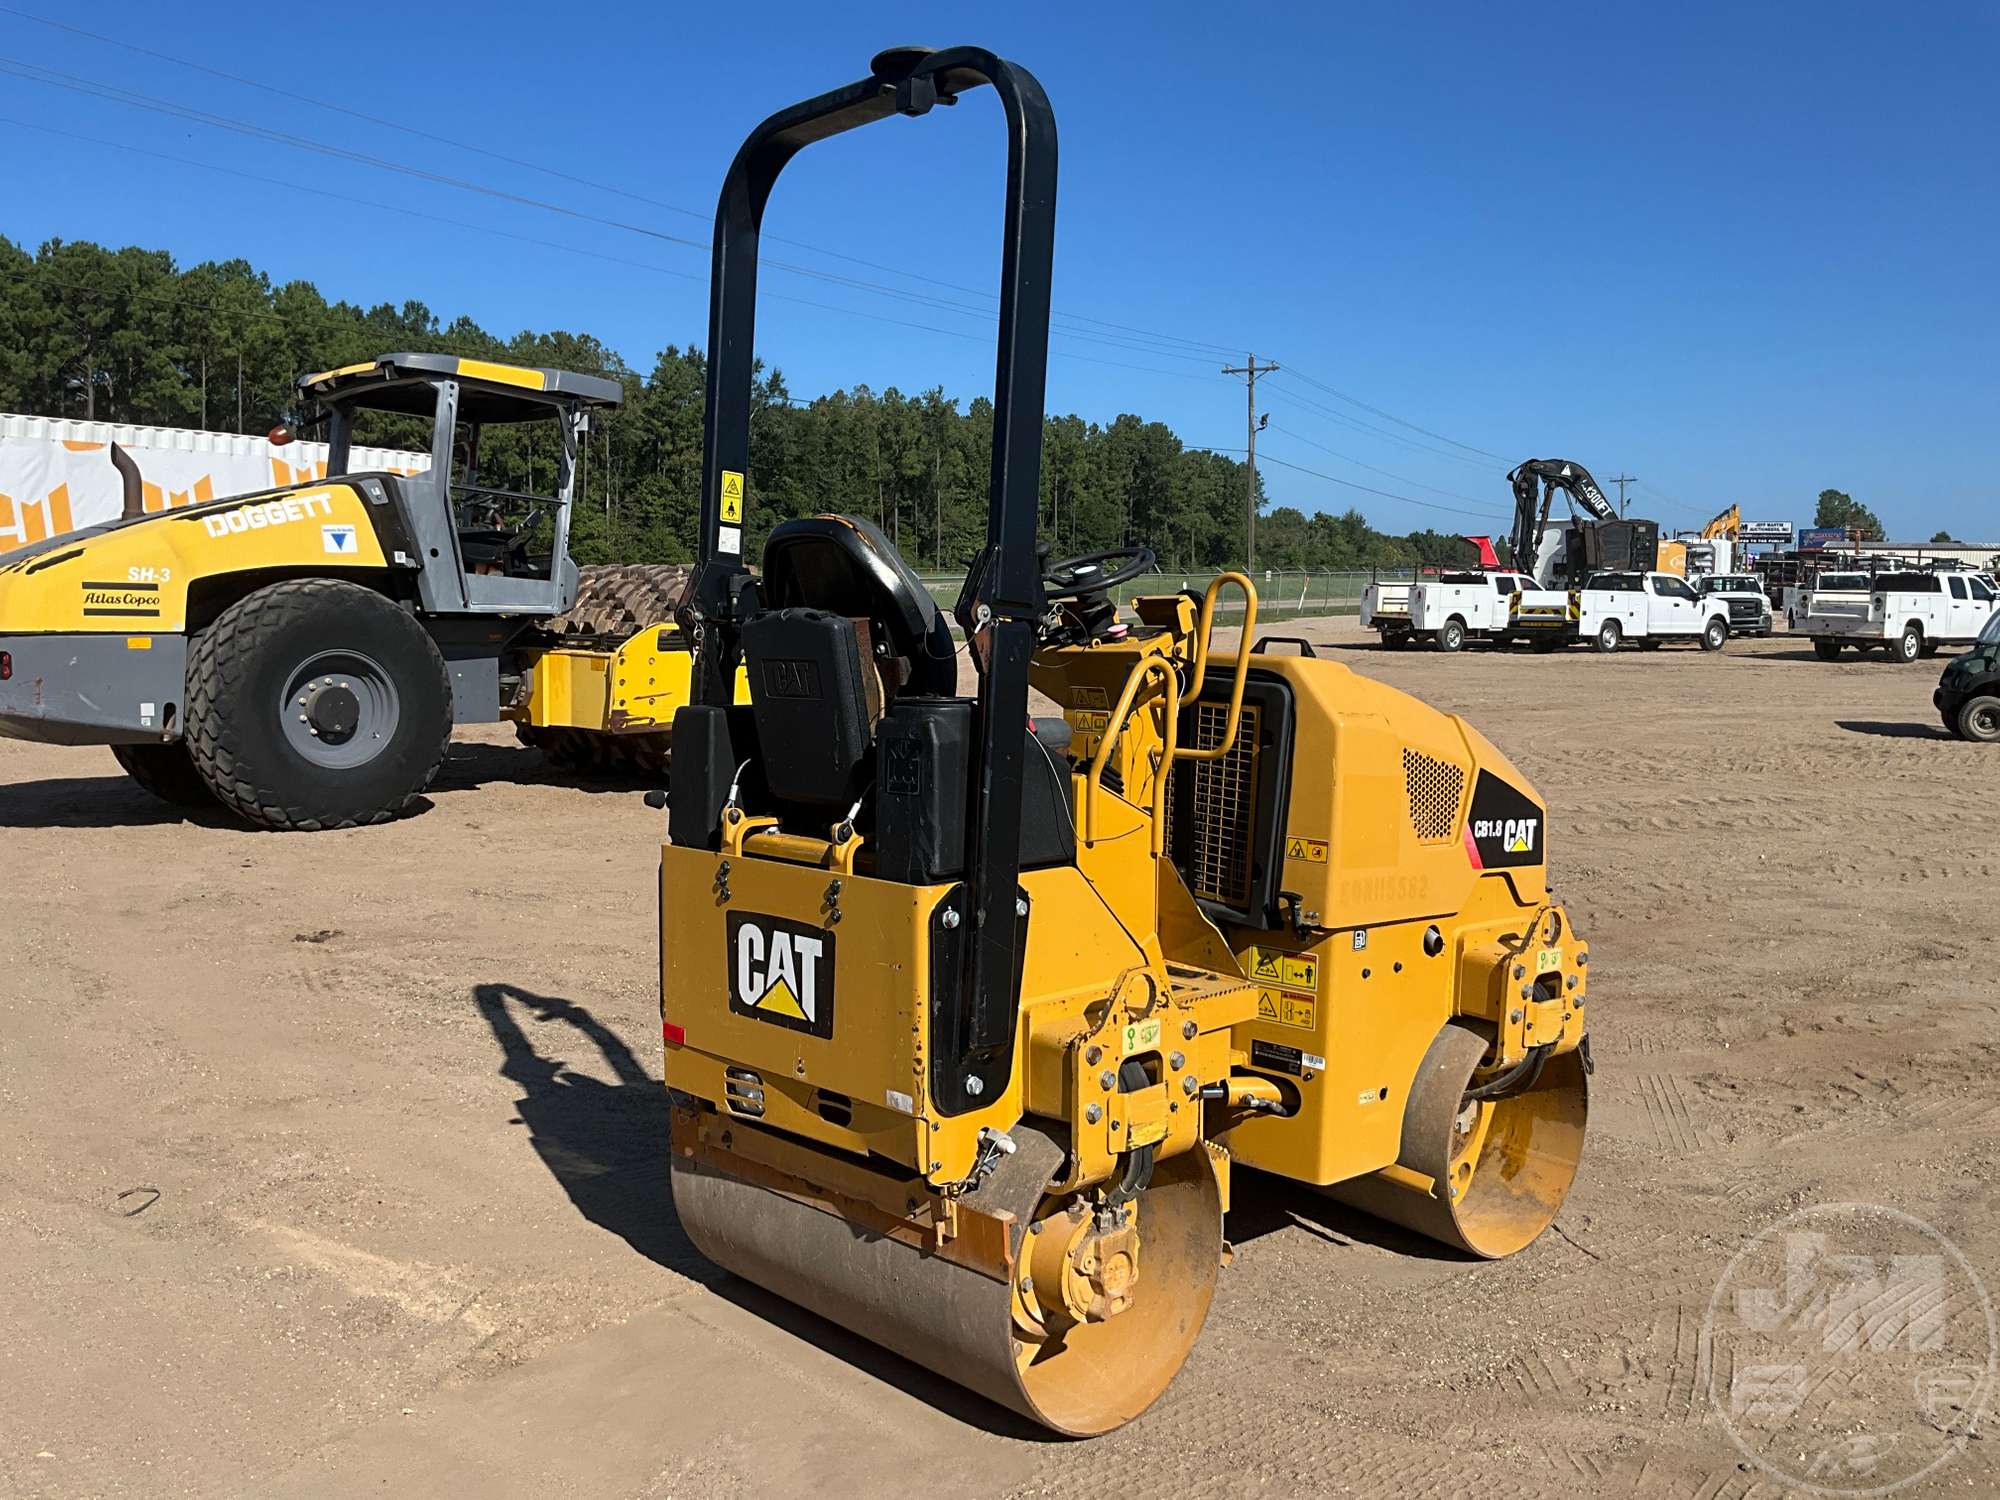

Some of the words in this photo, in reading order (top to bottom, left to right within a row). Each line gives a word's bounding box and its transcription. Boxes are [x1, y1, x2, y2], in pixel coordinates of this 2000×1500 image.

[202, 492, 333, 538] DOGGETT
[128, 566, 171, 582] SH-3
[84, 592, 121, 605] Atlas
[123, 593, 160, 606] Copco
[1474, 819, 1503, 838] CB1.8
[1503, 818, 1537, 853] CAT
[738, 922, 823, 1023] CAT
